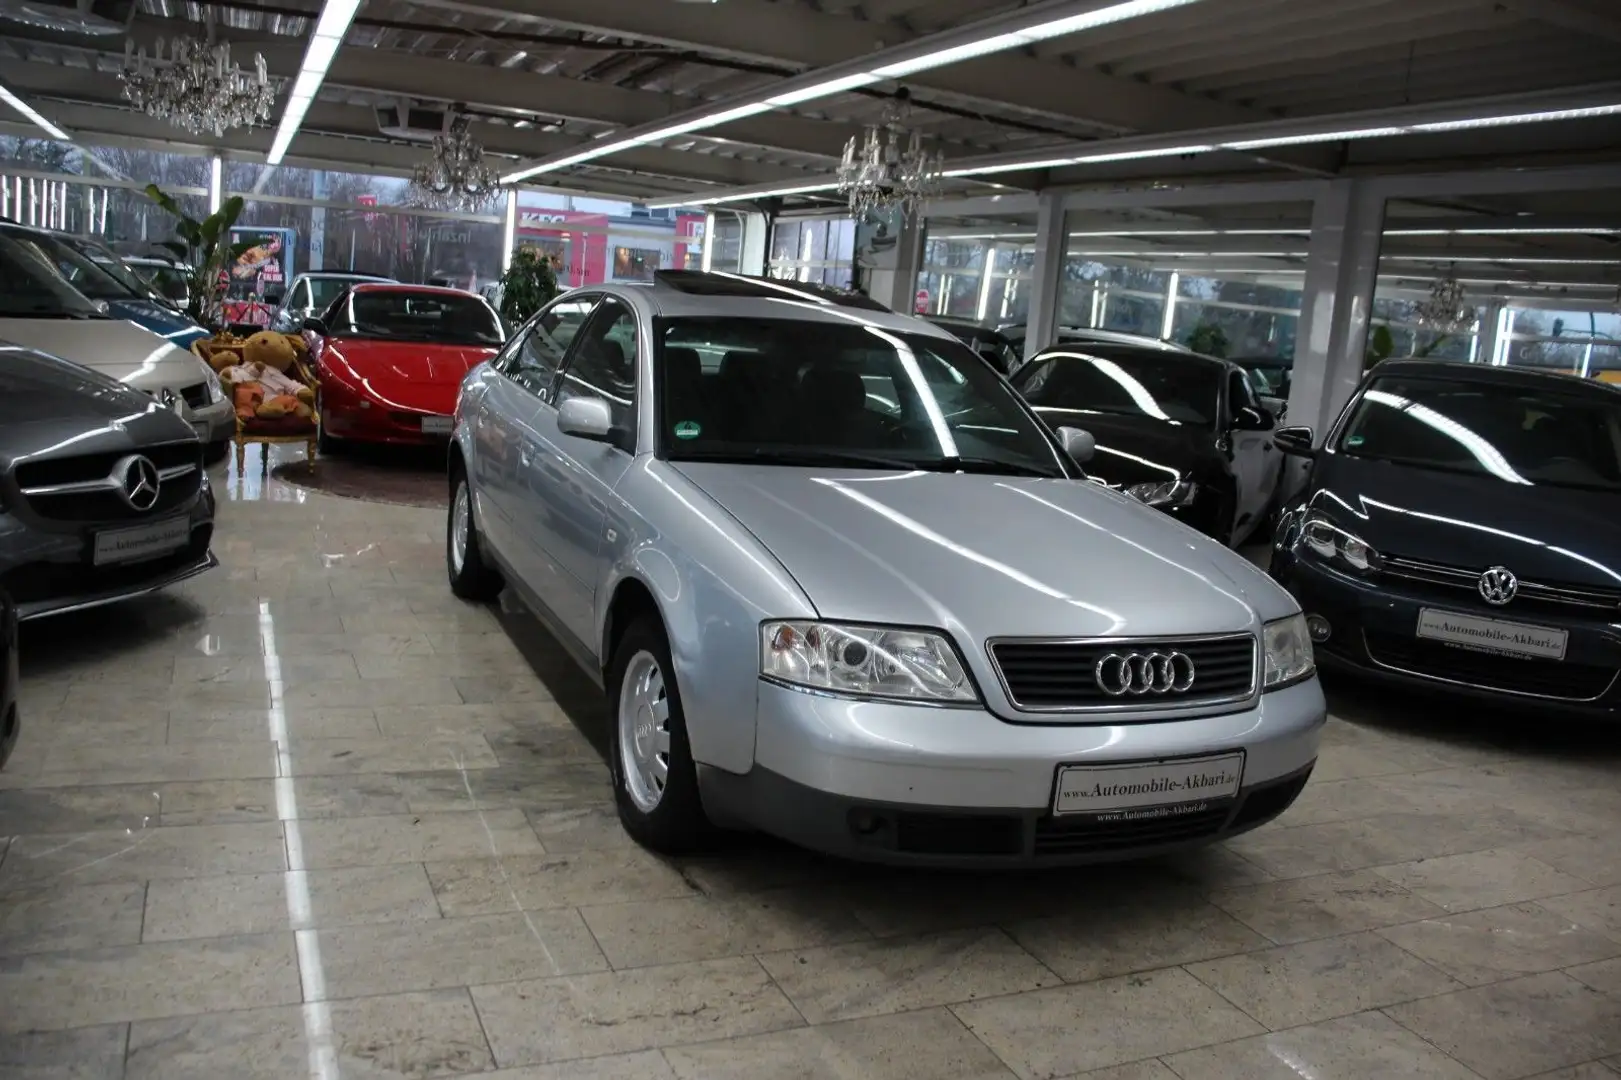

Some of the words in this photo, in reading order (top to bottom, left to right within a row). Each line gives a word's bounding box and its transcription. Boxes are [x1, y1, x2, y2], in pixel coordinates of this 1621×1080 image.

[521, 212, 565, 224] KFC
[1423, 622, 1562, 650] www.Automobile-Akbari.de
[1063, 771, 1236, 799] www.Automobile-Akbari.de
[1097, 802, 1207, 822] www.Automobile-Akbari.de
